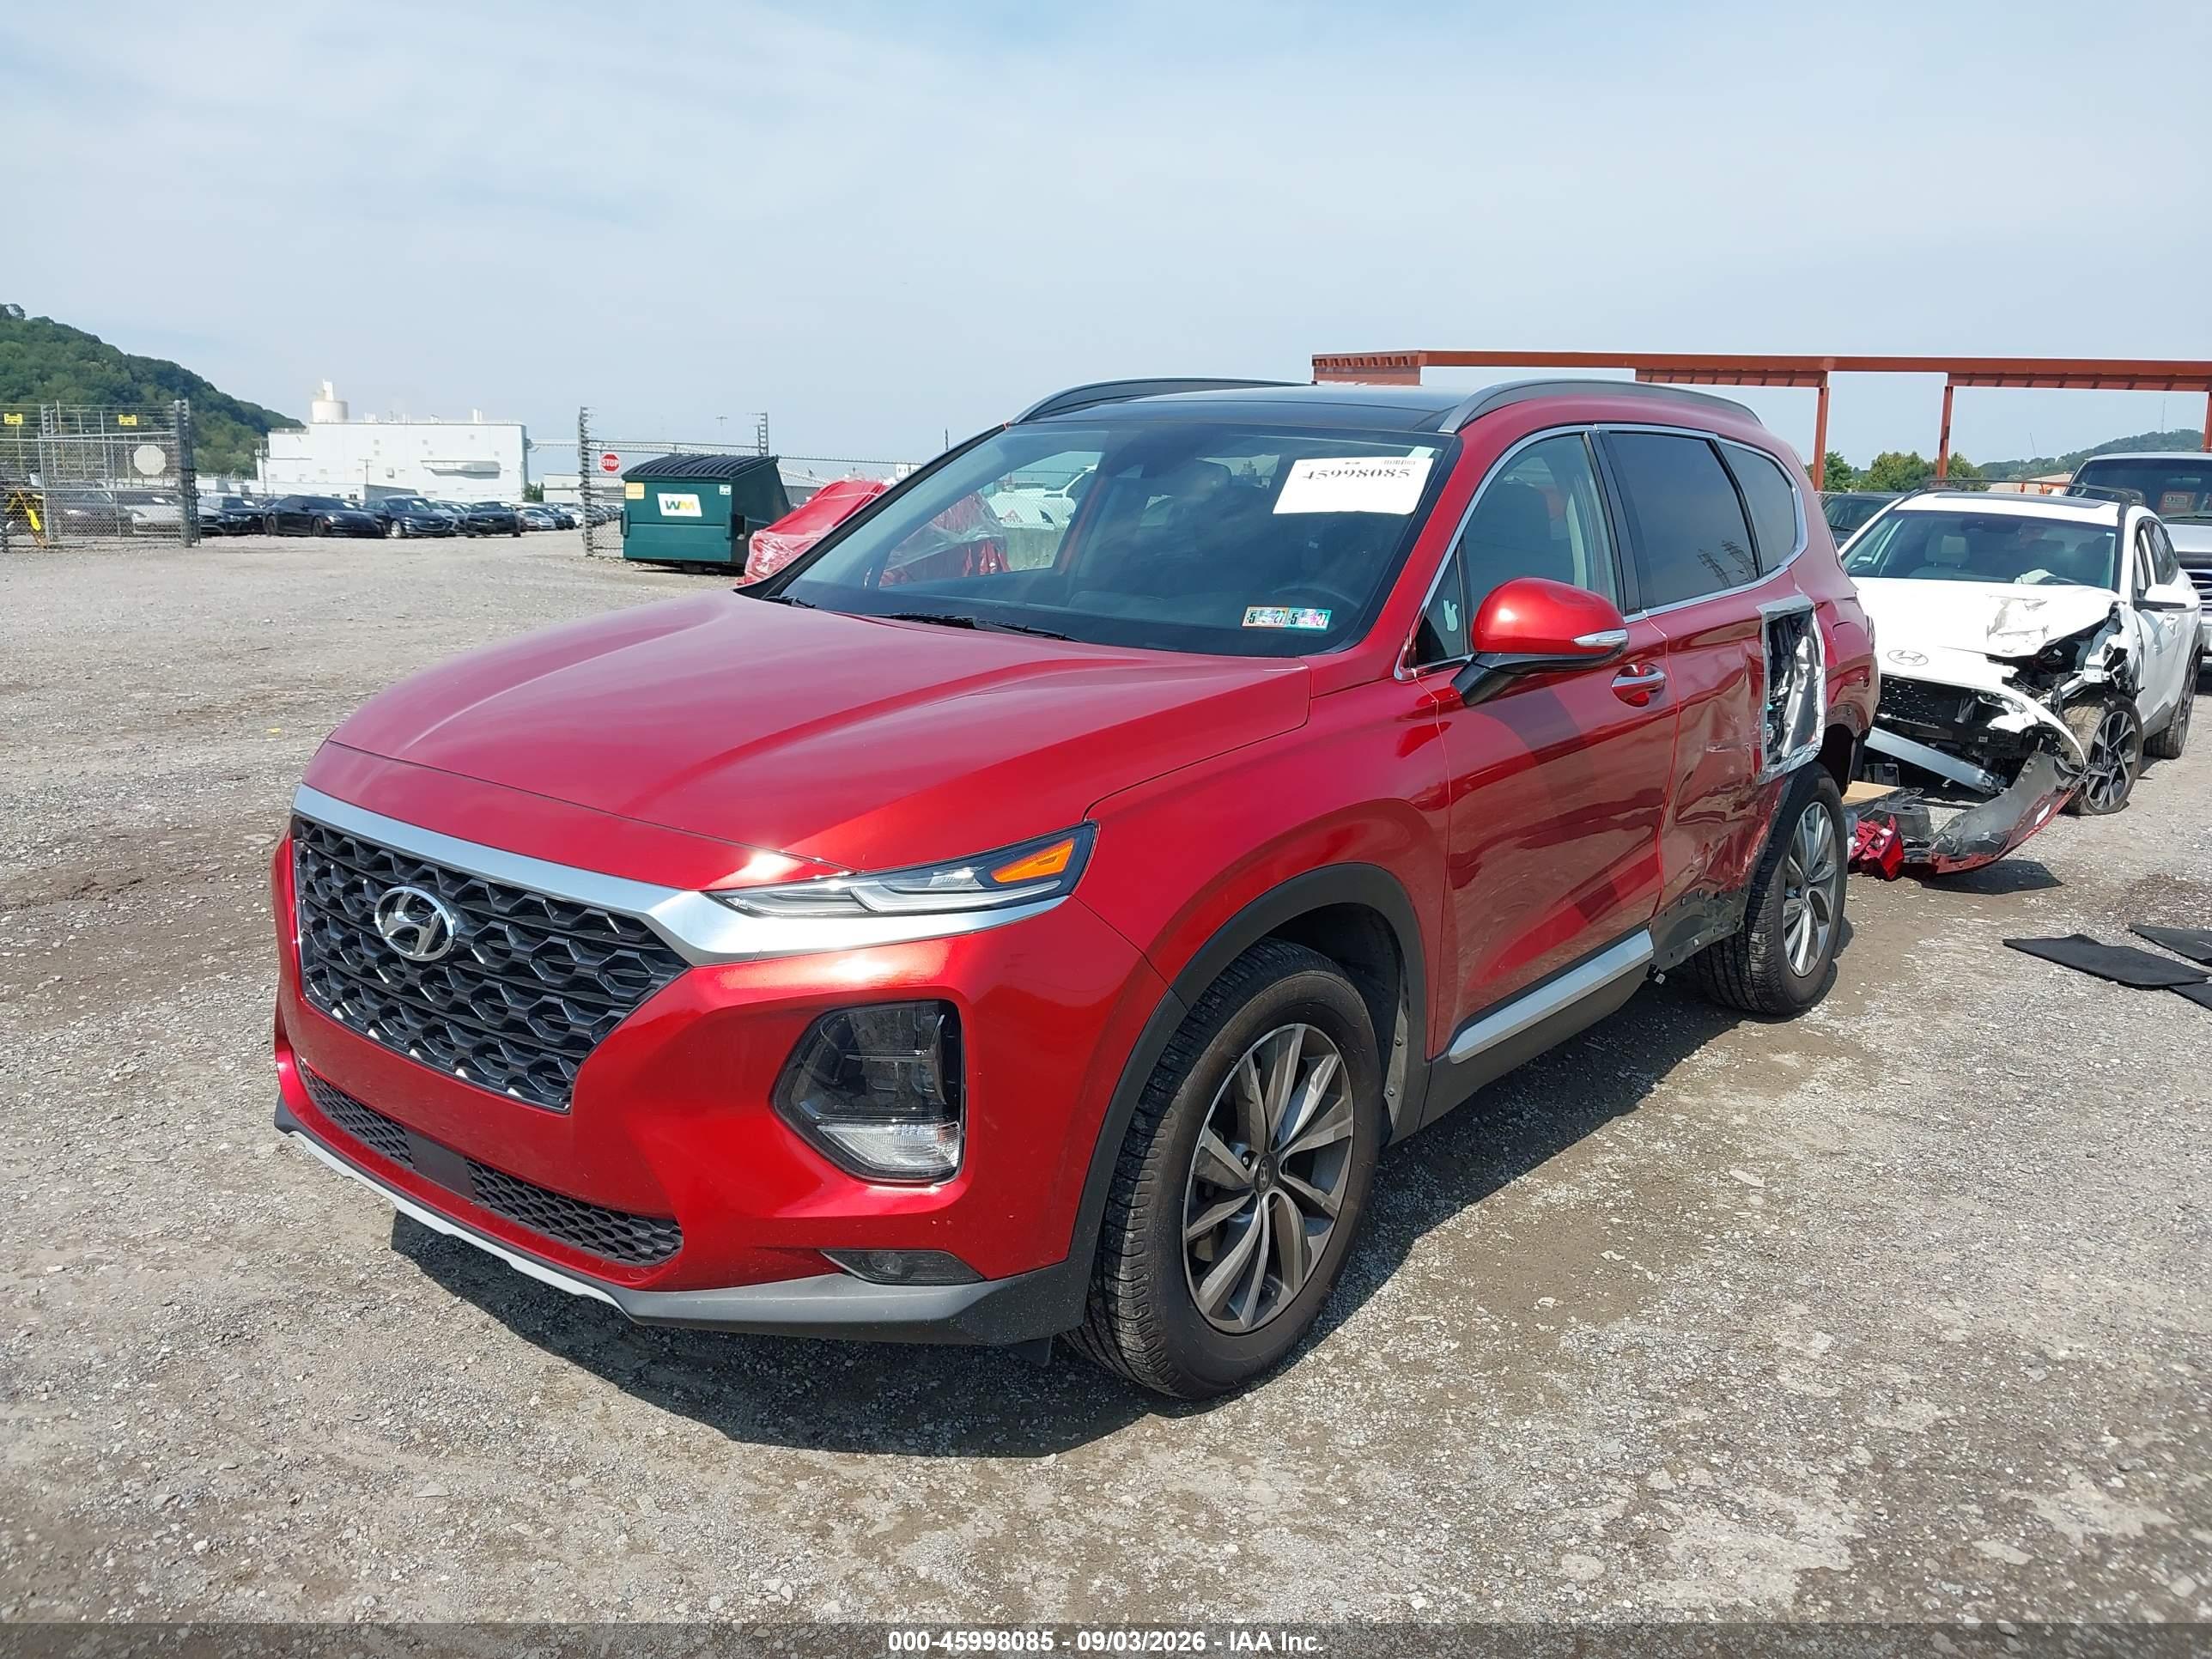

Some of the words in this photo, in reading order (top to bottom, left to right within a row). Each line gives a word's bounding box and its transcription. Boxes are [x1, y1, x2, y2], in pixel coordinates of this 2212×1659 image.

[600, 459, 619, 467] STOP
[1302, 468, 1412, 480] 45998085
[665, 500, 695, 510] WM
